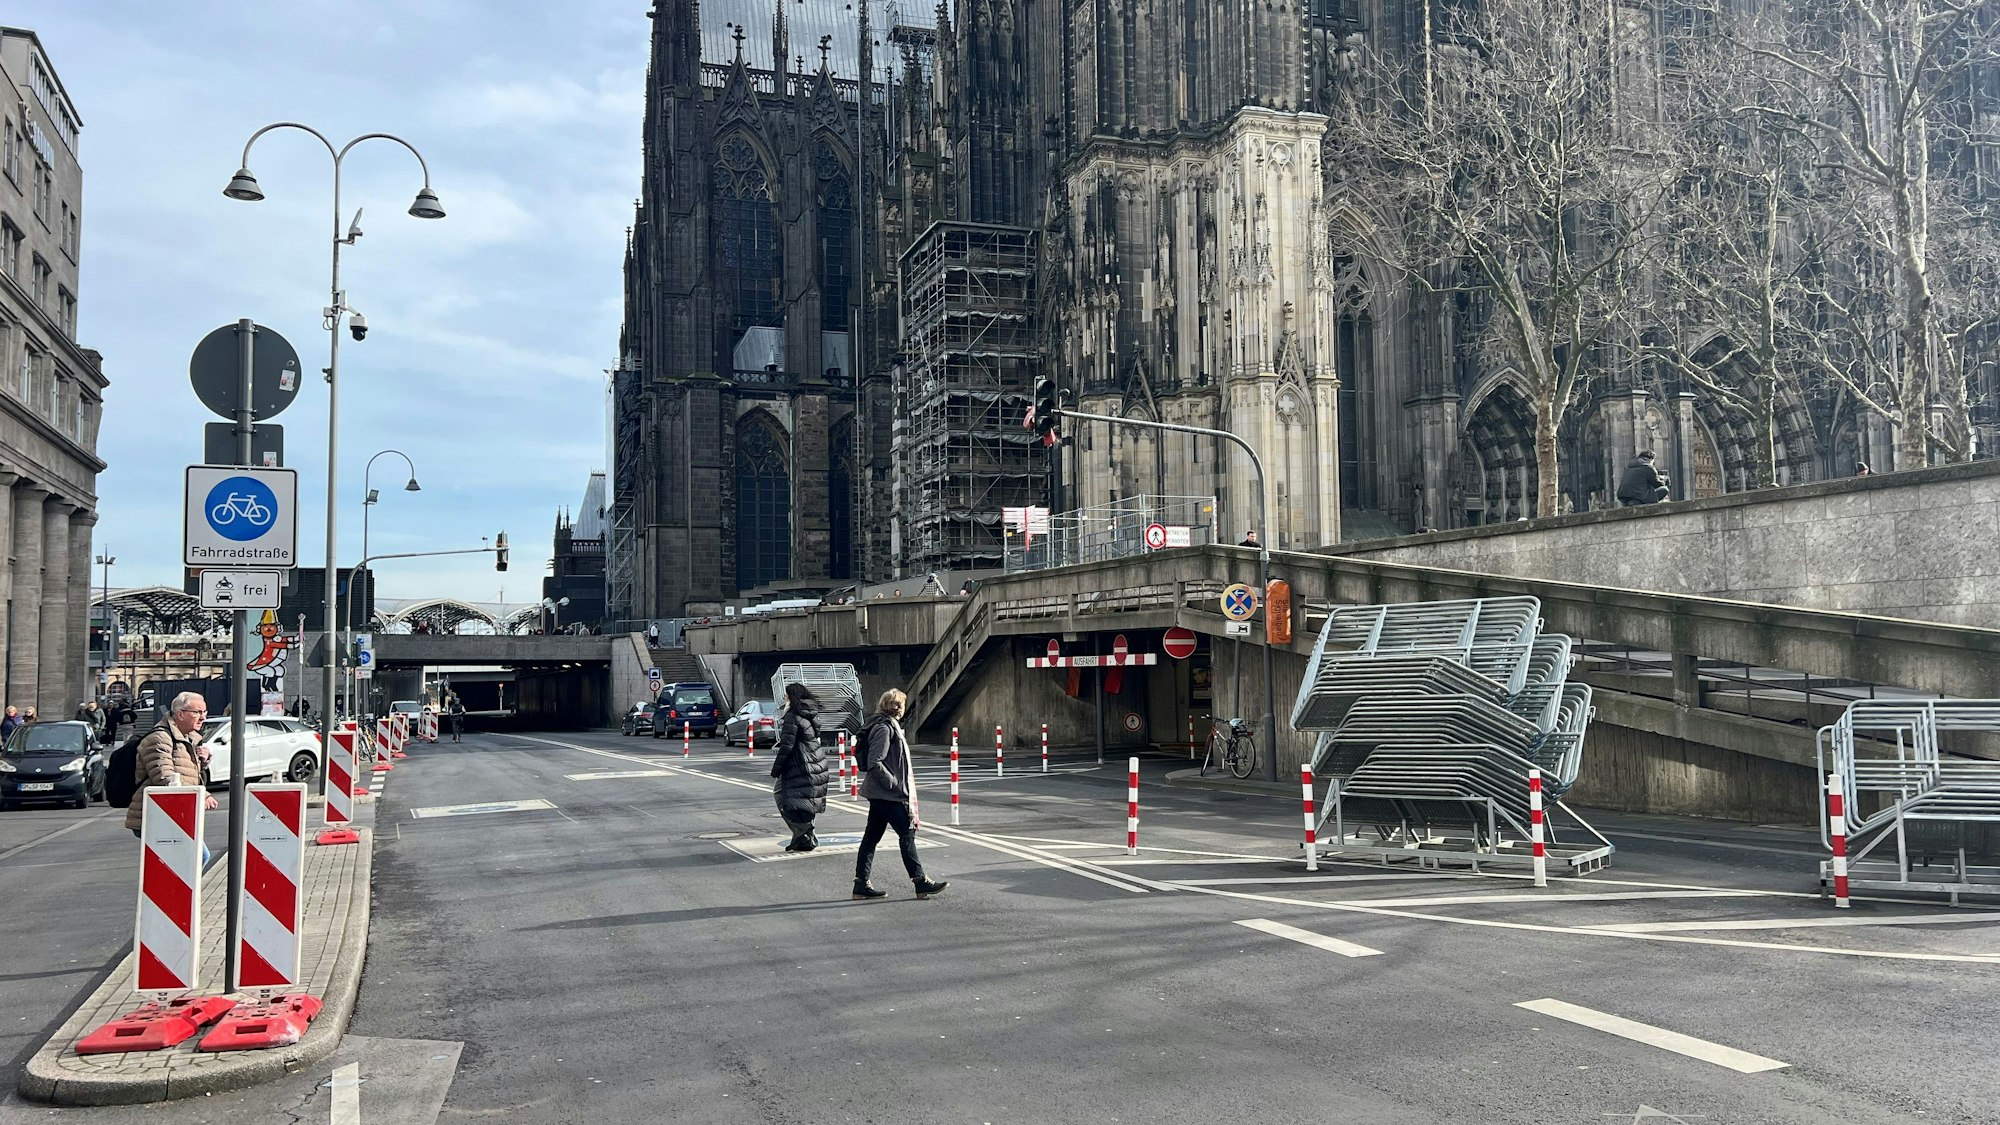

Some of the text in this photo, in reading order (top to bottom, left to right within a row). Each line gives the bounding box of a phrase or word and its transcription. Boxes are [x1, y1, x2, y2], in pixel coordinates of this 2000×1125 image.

[191, 546, 289, 558] Fahrradstraße
[243, 584, 267, 595] frei
[1074, 656, 1097, 665] AUSFAHRT
